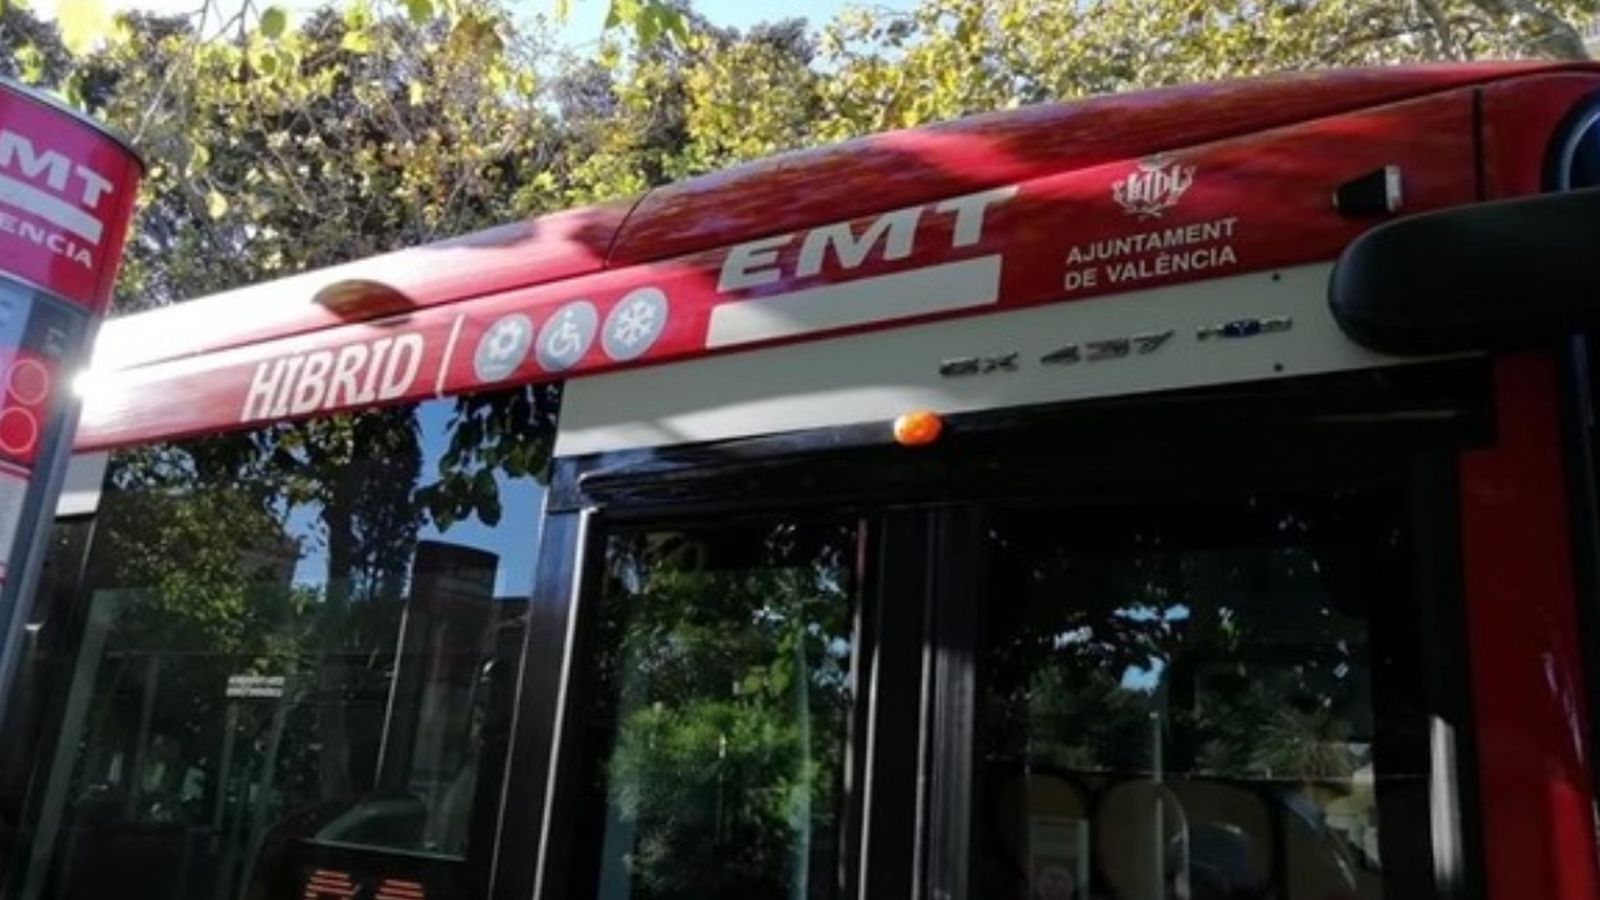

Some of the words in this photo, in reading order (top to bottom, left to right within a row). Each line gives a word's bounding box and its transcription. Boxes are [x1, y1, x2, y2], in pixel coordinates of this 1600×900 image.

[0, 130, 113, 208] MT
[0, 212, 93, 269] ENCIA
[717, 186, 1018, 292] EMT
[1066, 218, 1238, 265] AJUNTAMENT
[1064, 268, 1097, 291] DE
[1041, 330, 1174, 364] 437
